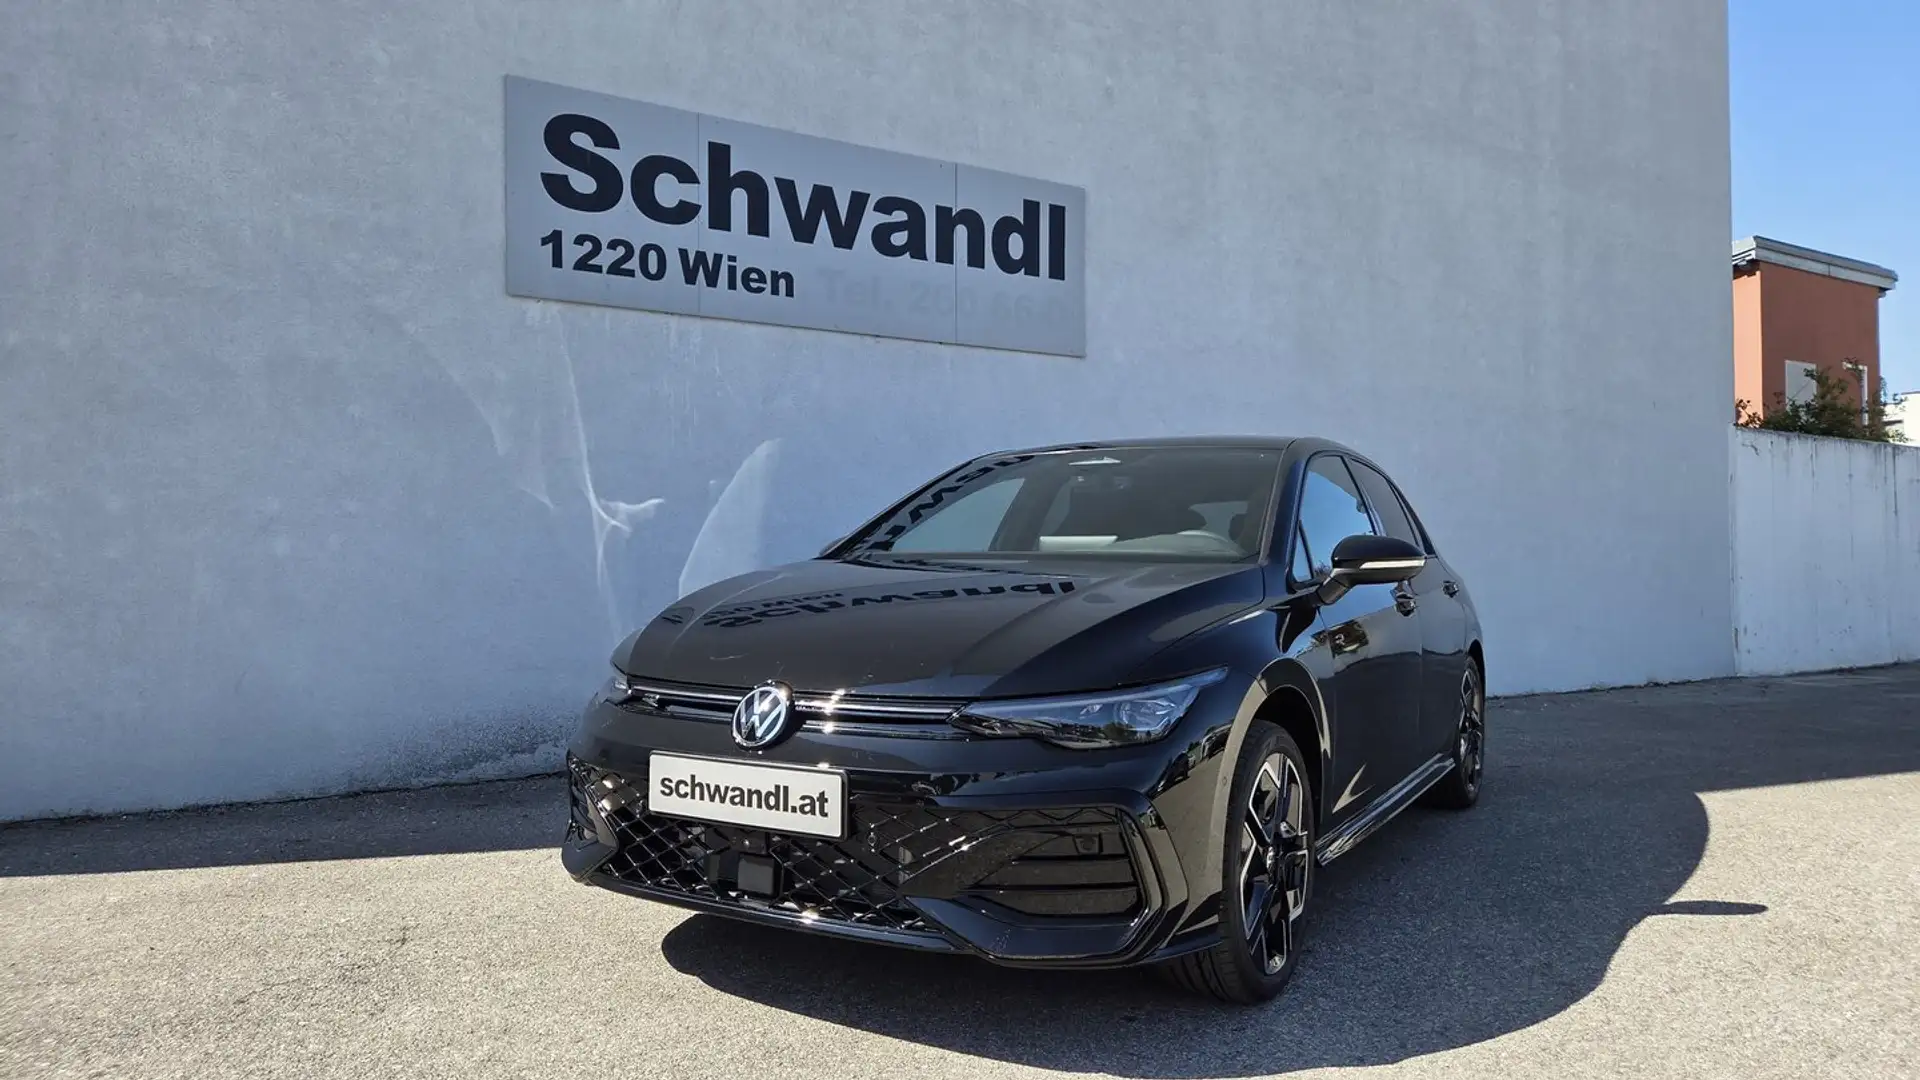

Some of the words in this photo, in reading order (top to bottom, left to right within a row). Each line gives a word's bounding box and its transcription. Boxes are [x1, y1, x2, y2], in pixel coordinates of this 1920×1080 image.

[540, 113, 1066, 282] Schwandl
[540, 229, 667, 282] 1220
[678, 247, 795, 299] Wien
[737, 688, 786, 743] VW
[659, 774, 829, 818] schwandl.at
